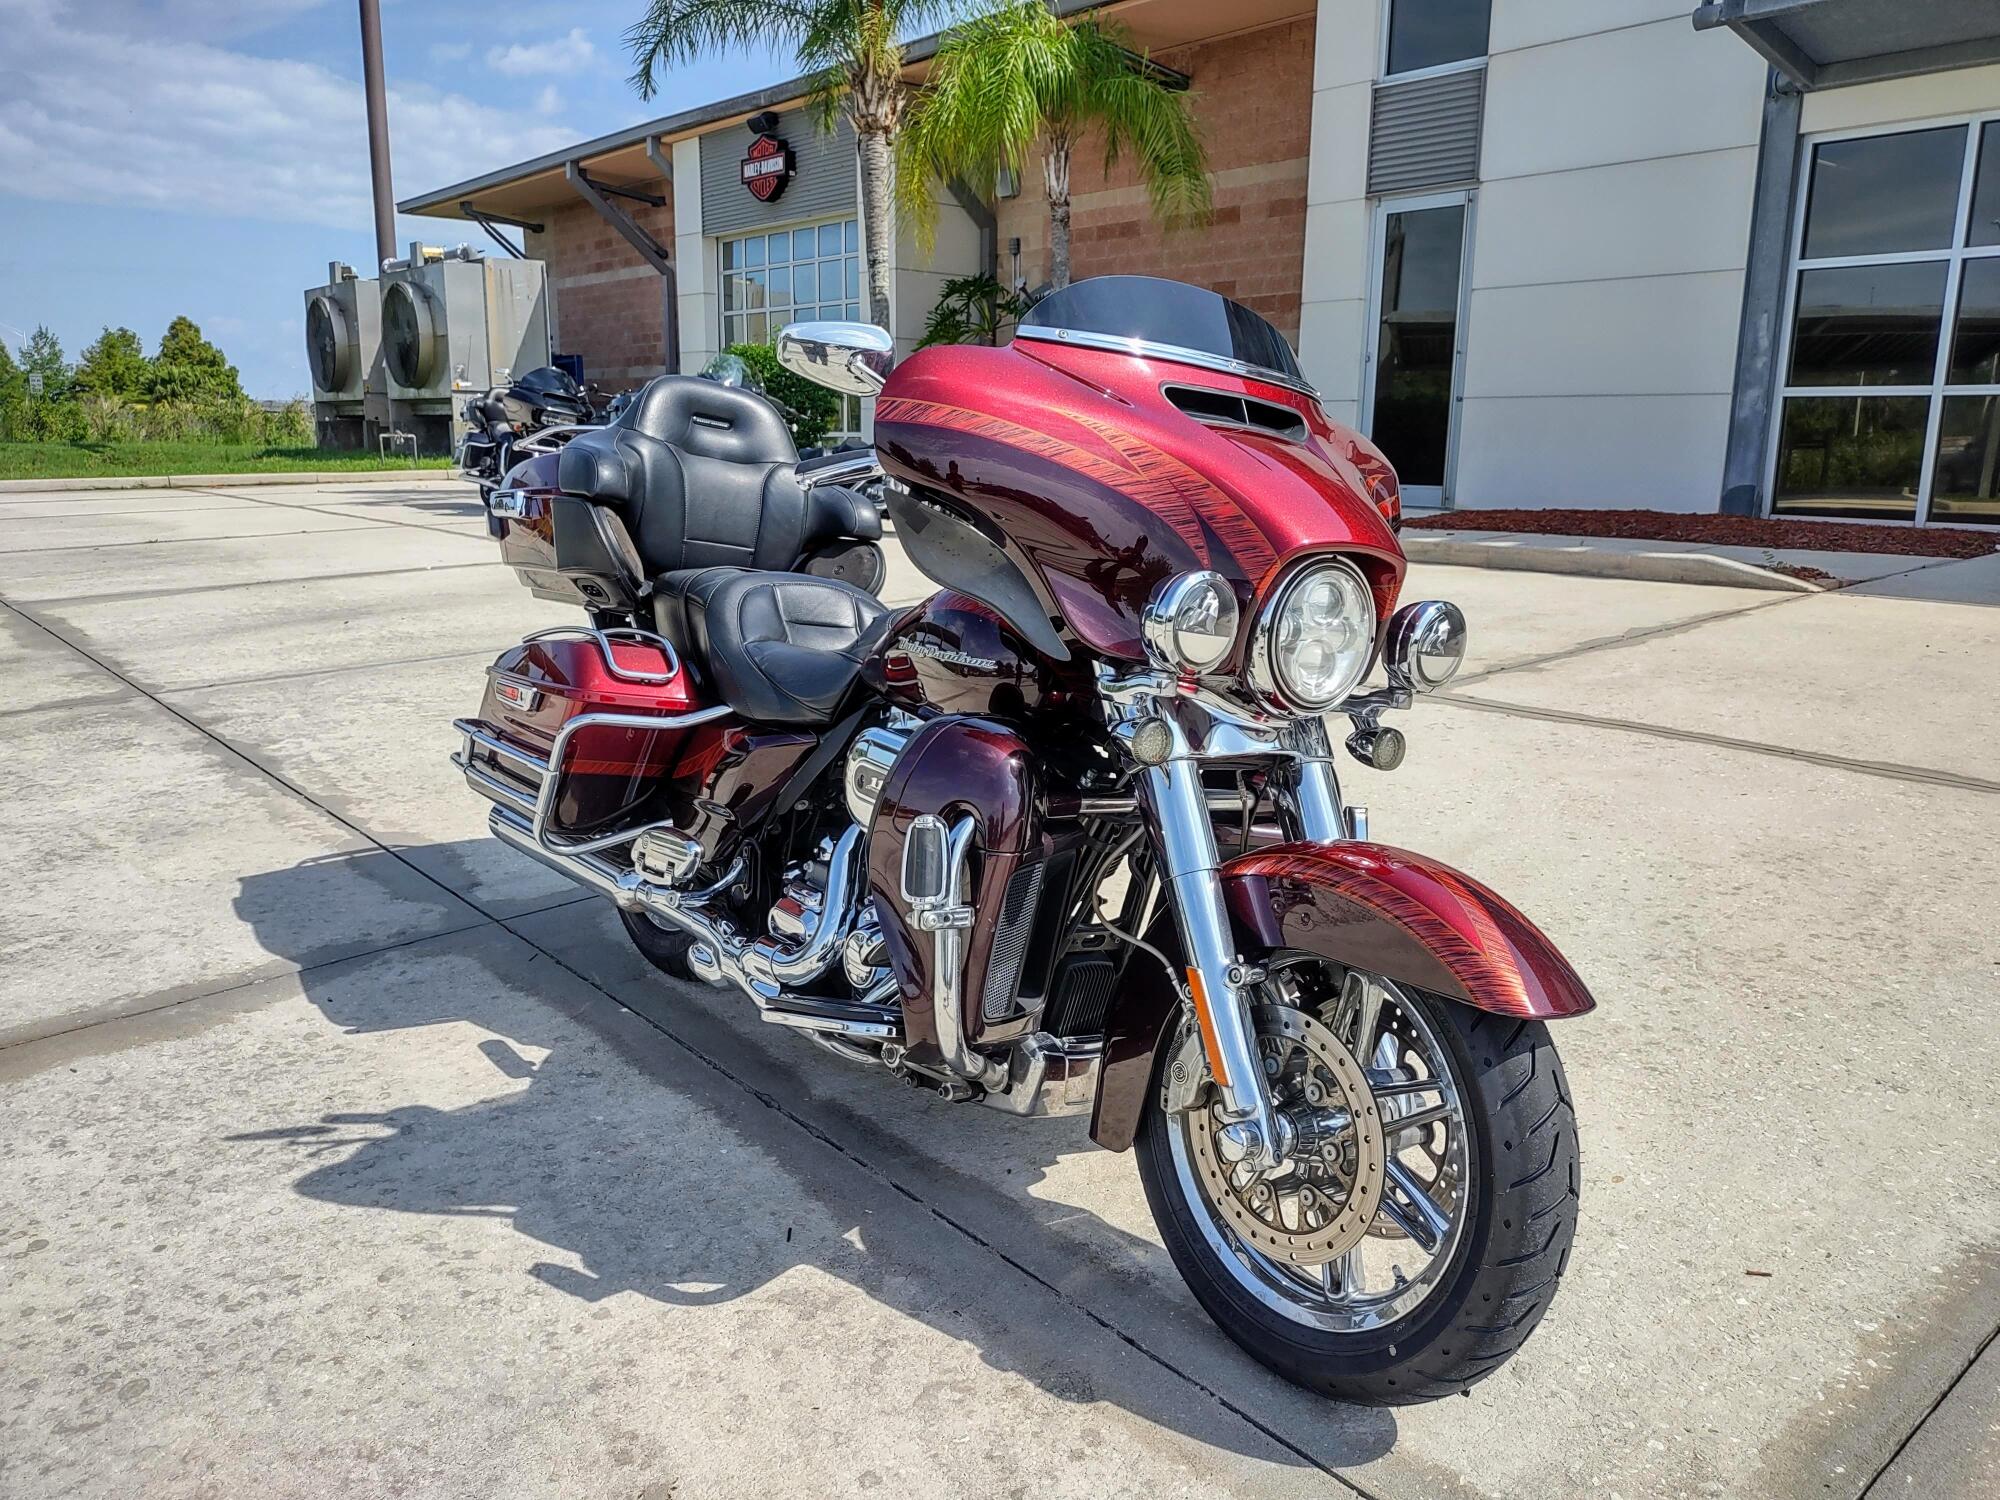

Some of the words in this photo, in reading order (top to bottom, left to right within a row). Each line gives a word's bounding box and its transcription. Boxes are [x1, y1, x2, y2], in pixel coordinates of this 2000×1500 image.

[753, 142, 774, 157] MOTOR
[744, 156, 784, 178] HARLEY-DAVIDSON
[753, 178, 775, 195] CYCLES
